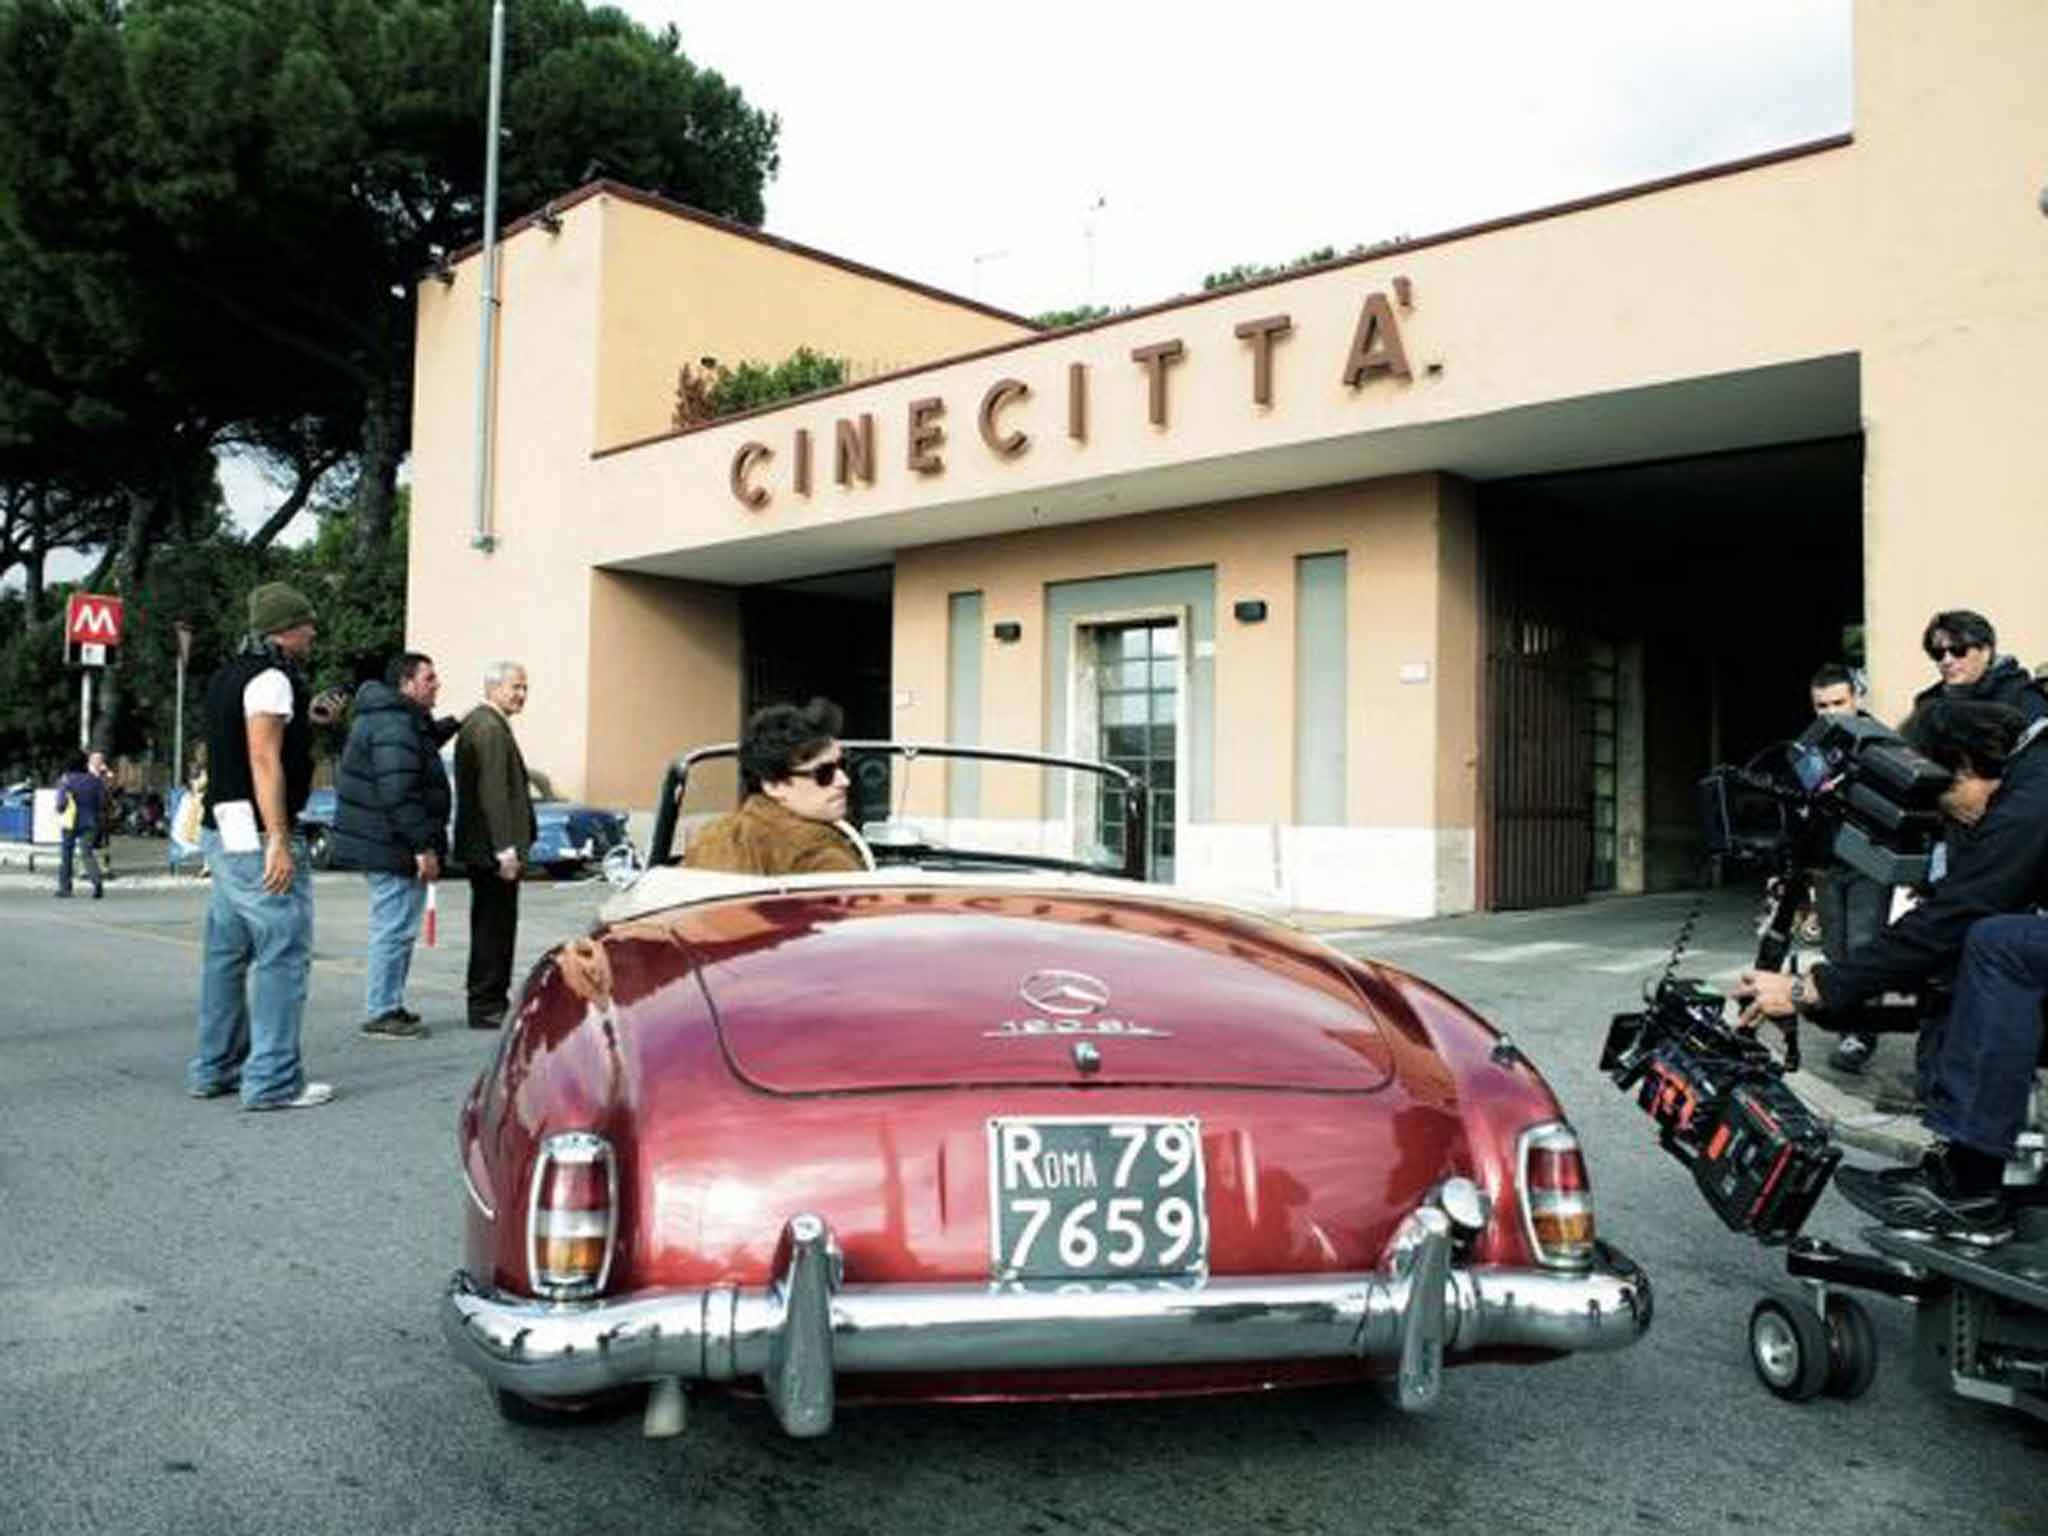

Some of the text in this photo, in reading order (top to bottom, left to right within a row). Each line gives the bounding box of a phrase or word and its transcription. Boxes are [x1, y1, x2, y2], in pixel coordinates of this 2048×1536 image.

[72, 604, 117, 635] M
[1108, 1126, 1194, 1188] 79
[1010, 1197, 1195, 1269] 7659
